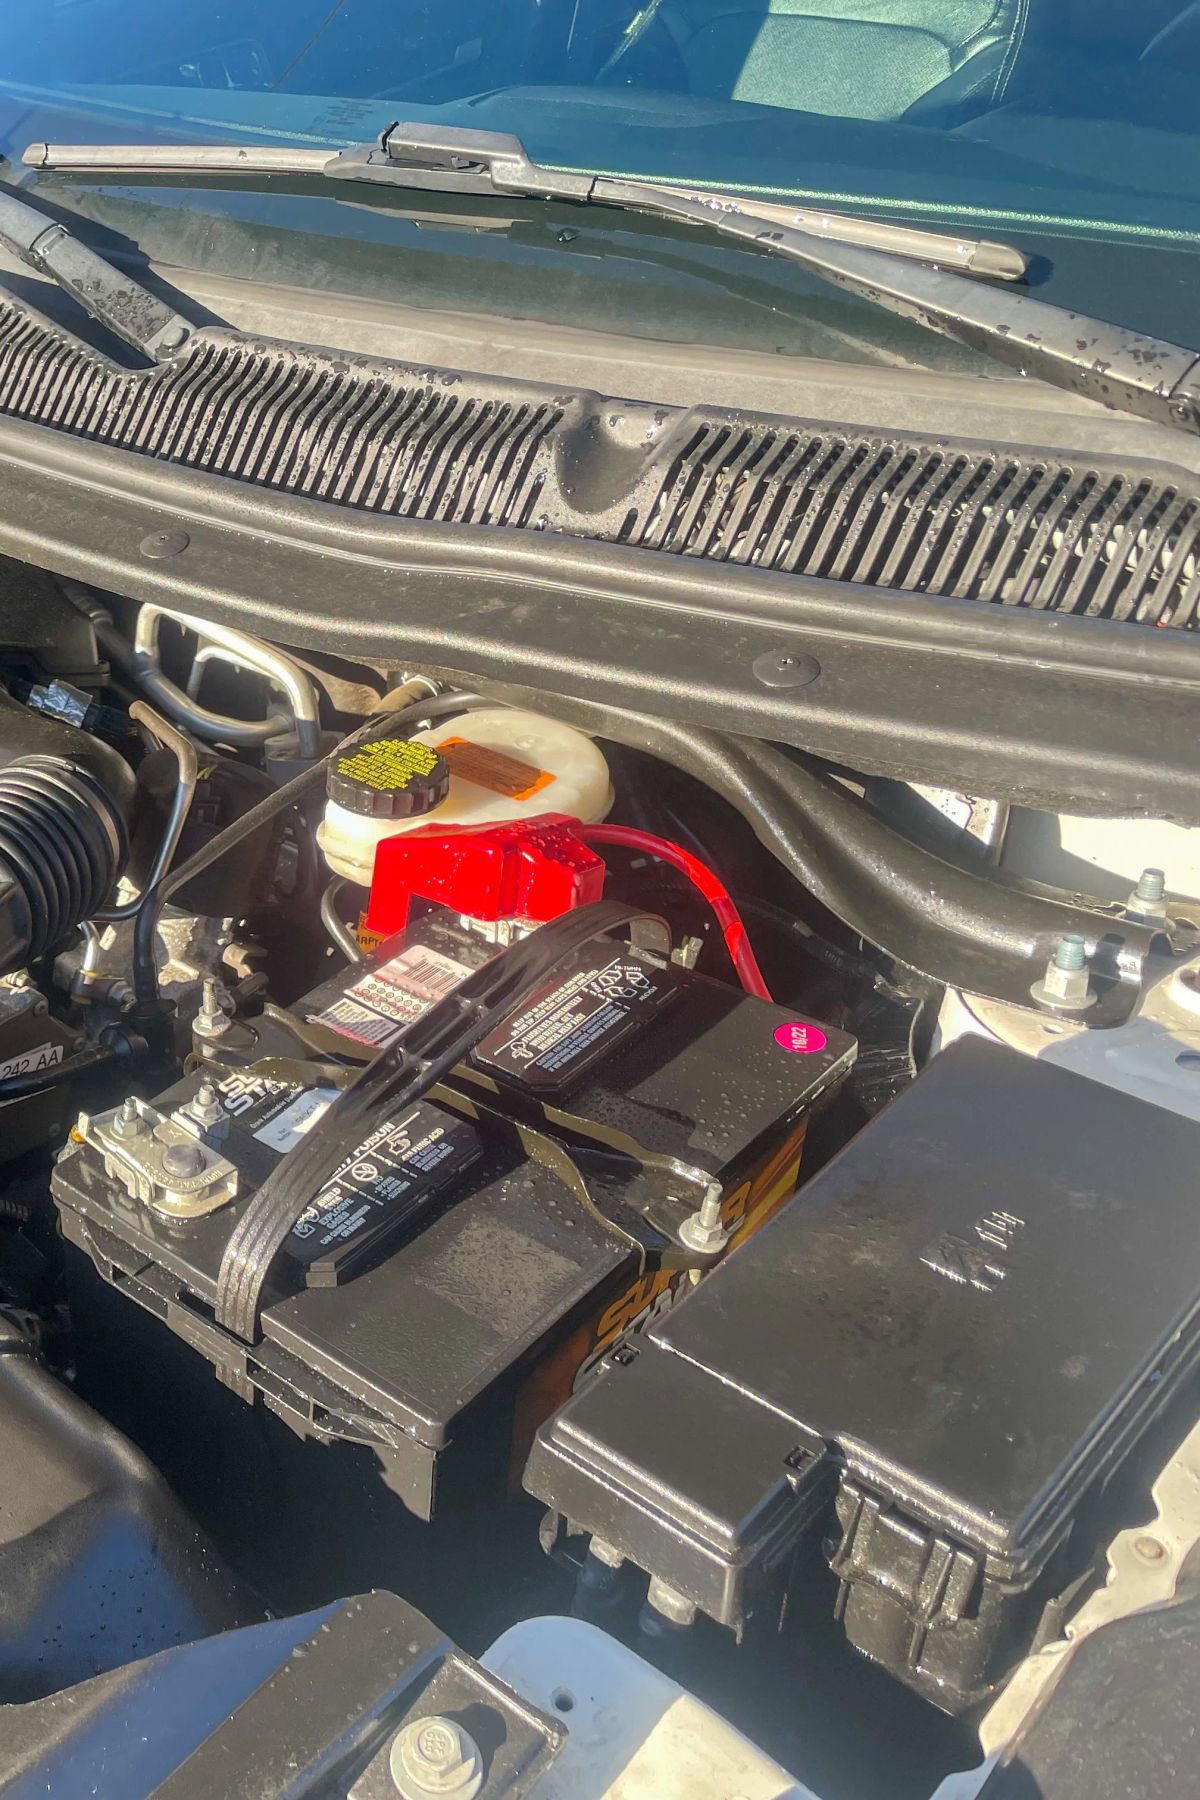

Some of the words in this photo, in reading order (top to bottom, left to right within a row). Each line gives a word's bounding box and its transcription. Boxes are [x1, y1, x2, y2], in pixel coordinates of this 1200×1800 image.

[791, 1026, 808, 1049] 10/22
[3, 1059, 30, 1078] 242
[36, 1049, 59, 1070] AA
